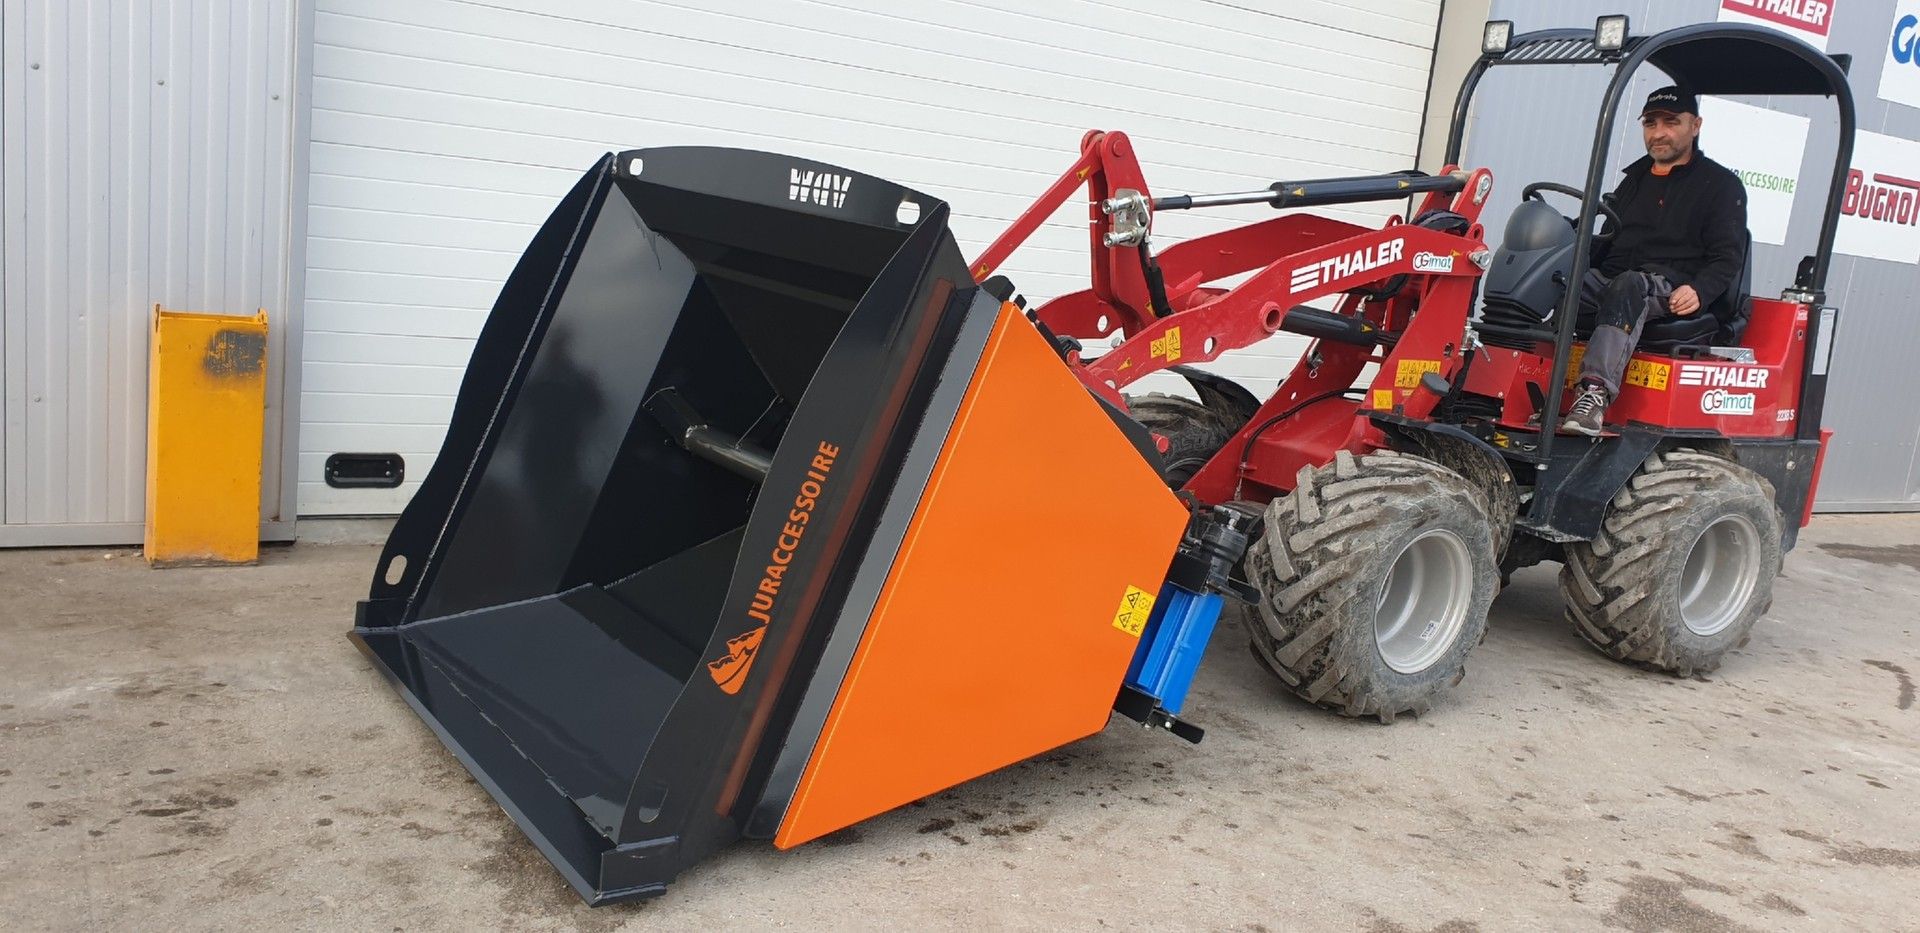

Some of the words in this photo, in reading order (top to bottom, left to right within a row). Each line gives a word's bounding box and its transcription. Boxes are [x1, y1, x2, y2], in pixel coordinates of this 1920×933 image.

[1320, 238, 1405, 284] THALER
[1703, 366, 1769, 388] THALER
[748, 440, 840, 625] JURACCESSOIRE
